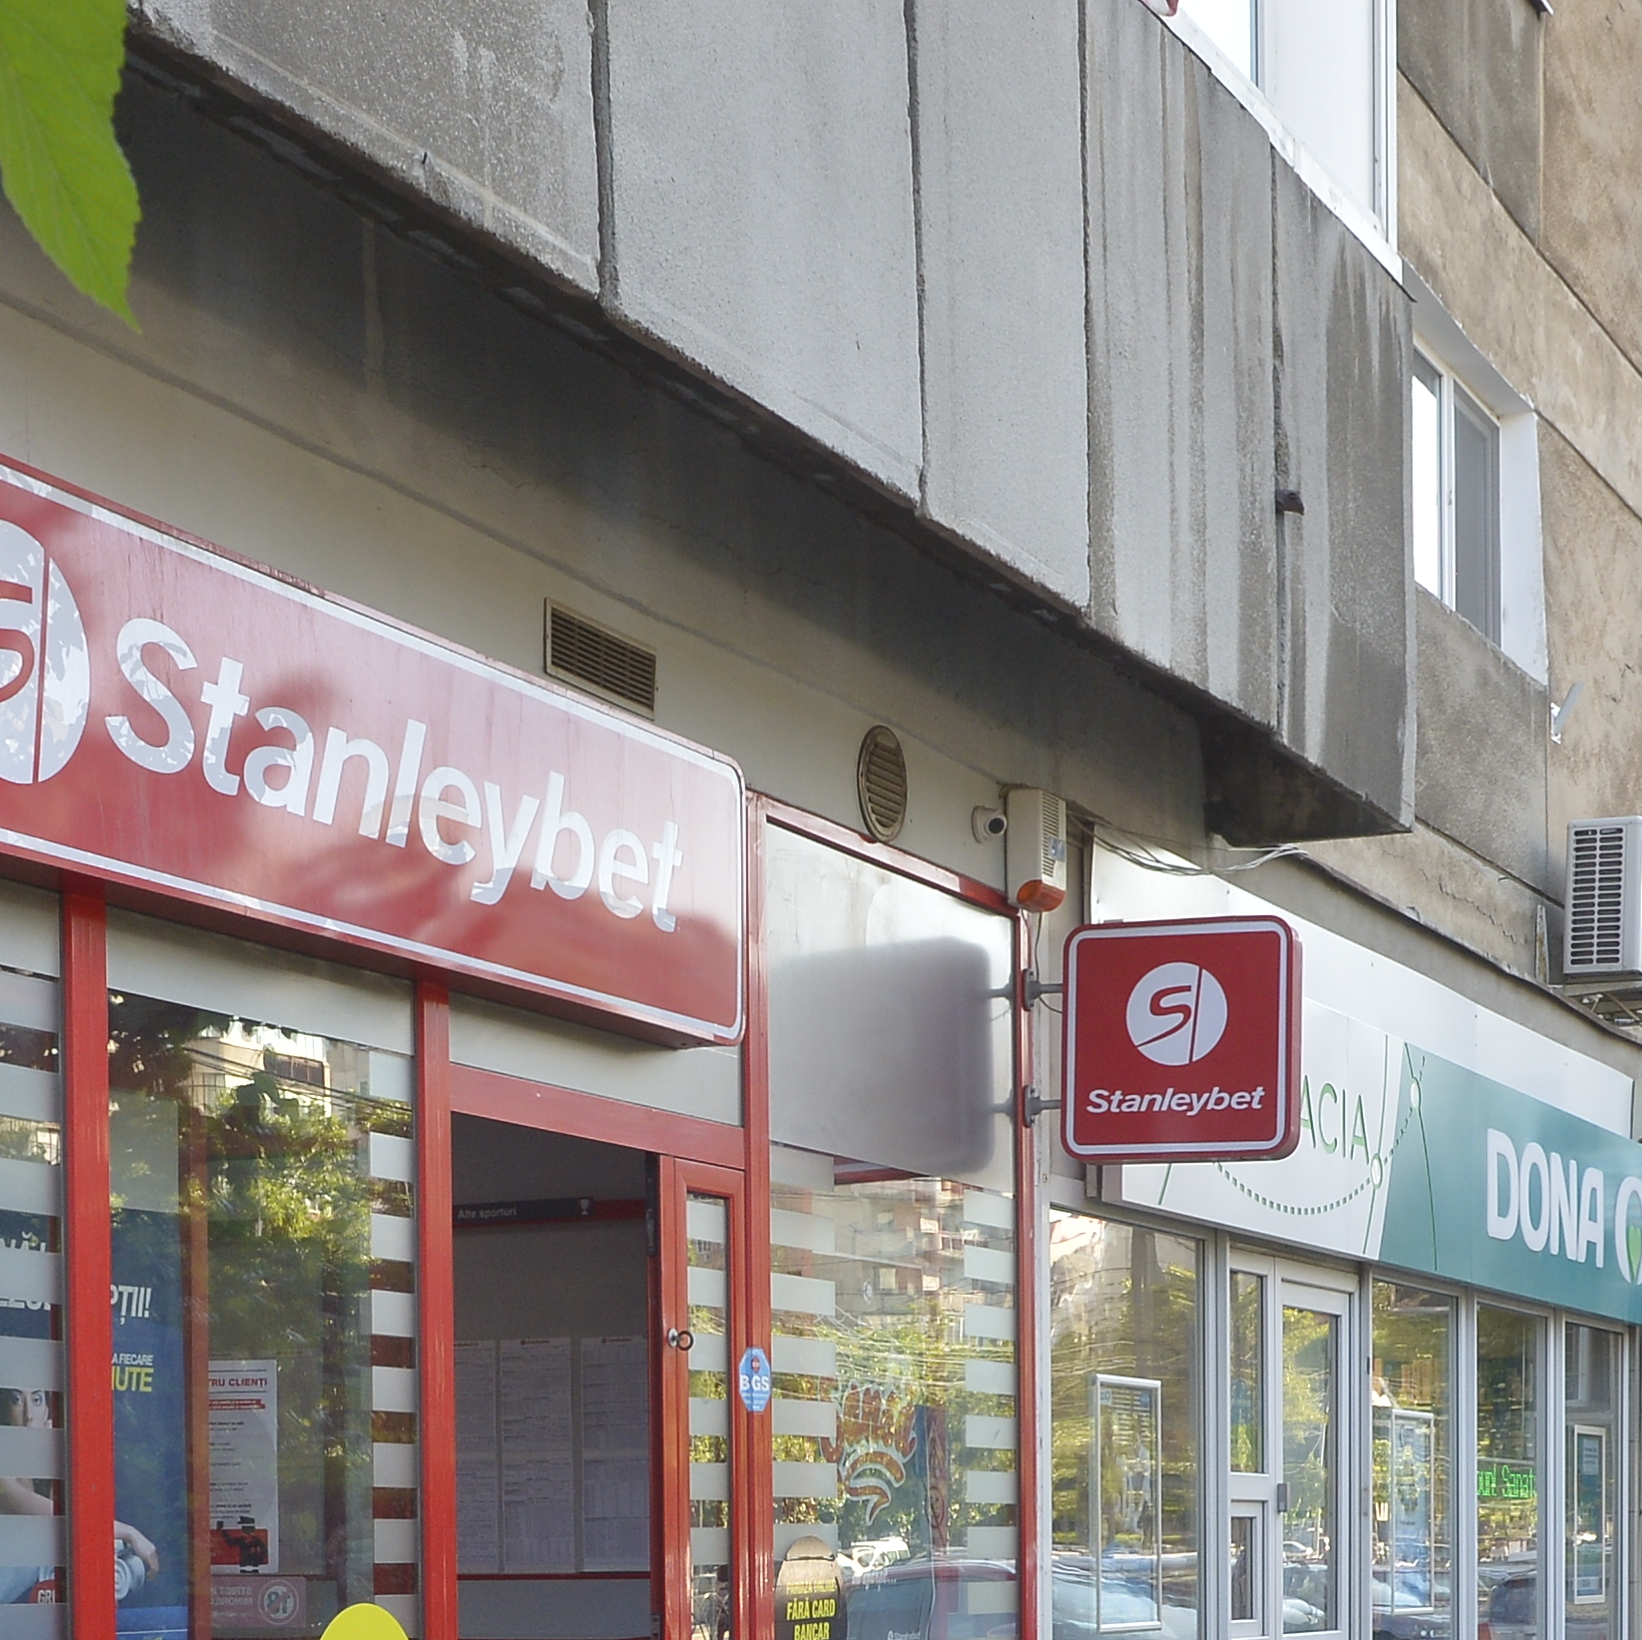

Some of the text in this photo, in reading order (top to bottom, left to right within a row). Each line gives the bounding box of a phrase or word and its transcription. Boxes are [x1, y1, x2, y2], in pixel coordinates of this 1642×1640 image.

[104, 616, 684, 933] Stanleybet
[1086, 1085, 1266, 1117] Stanleybet
[1486, 1127, 1605, 1269] DONA
[740, 1374, 770, 1392] BGS
[811, 1598, 836, 1618] CARD
